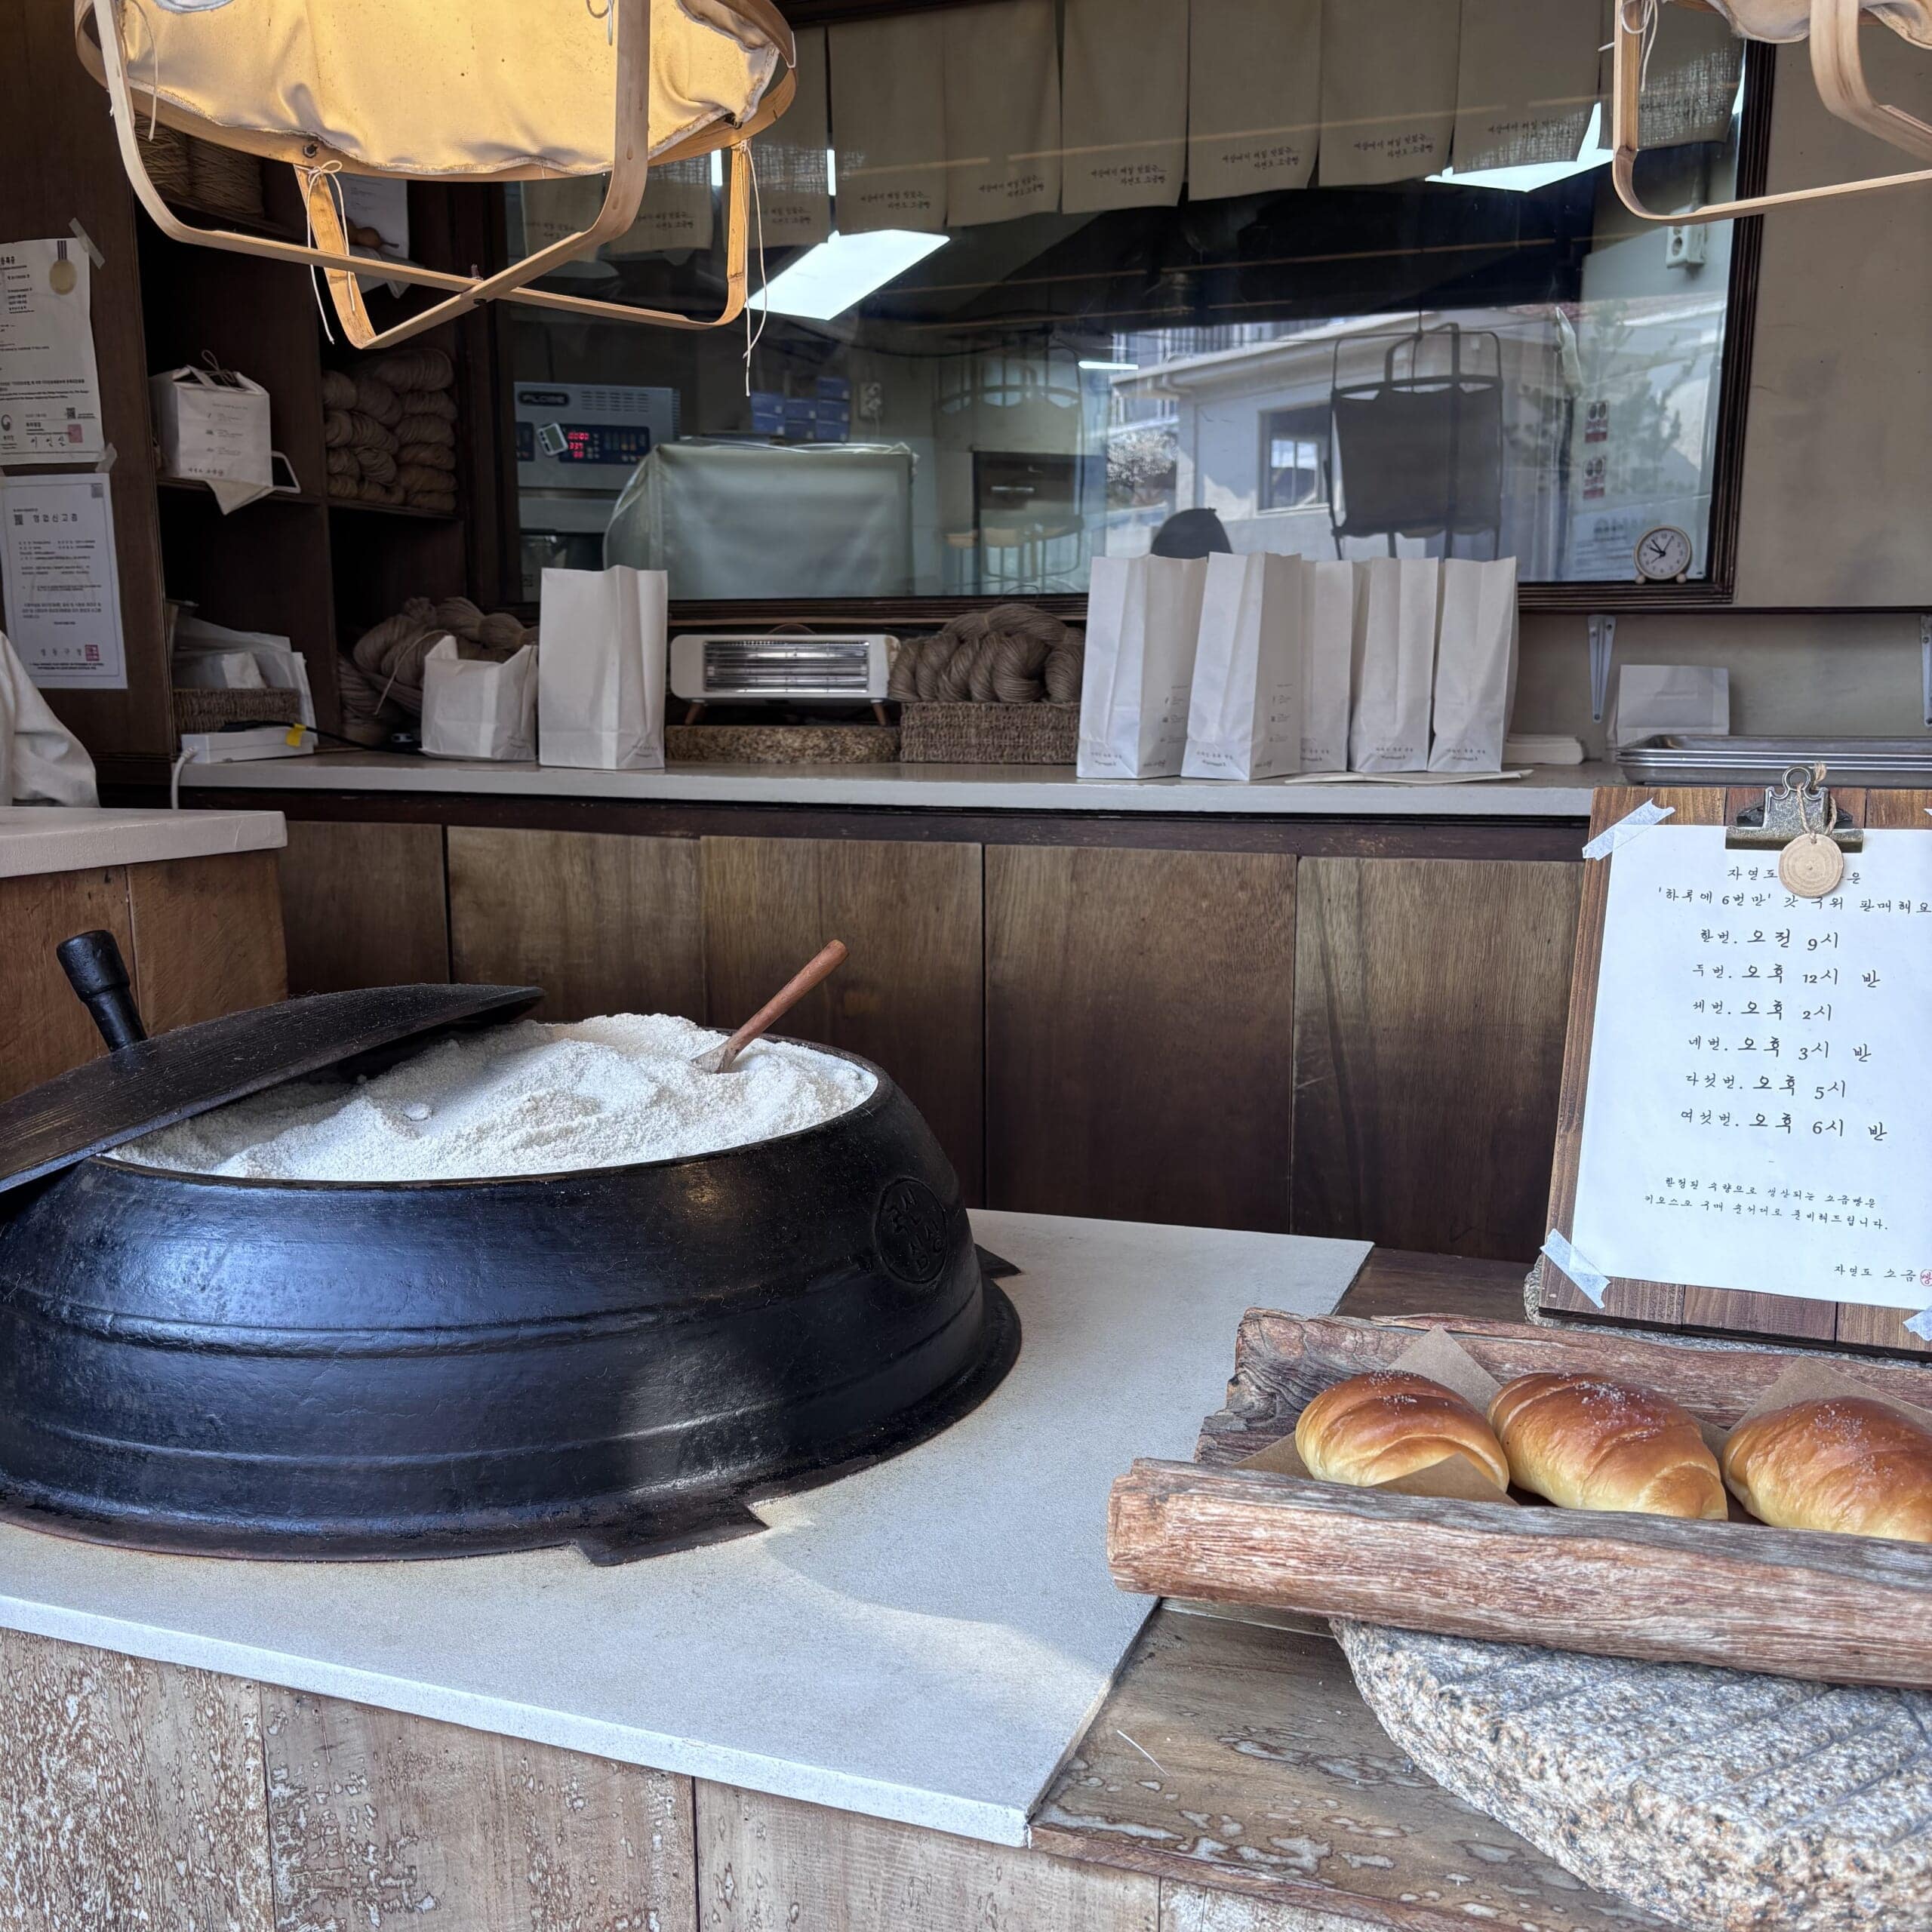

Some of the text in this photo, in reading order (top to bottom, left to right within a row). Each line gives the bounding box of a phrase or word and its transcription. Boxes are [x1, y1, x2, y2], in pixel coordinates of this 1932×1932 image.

[1727, 866, 1778, 881] 자연도
[1859, 898, 1932, 914] 판매해요
[1746, 928, 1791, 949] 오전
[1807, 931, 1838, 952] 9시
[1741, 963, 1783, 984] 오후
[1801, 968, 1838, 986] 12시
[1861, 969, 1881, 989] 반
[1740, 999, 1783, 1021] 오후
[1801, 1003, 1832, 1022] 2시
[1737, 1036, 1780, 1058] 오후
[1798, 1040, 1829, 1061] 3시
[1852, 1043, 1872, 1063] 반
[1752, 1074, 1795, 1097] 오후
[1814, 1079, 1846, 1100] 5시
[1748, 1112, 1792, 1134] 오후
[1812, 1118, 1844, 1137] 6시
[1867, 1121, 1888, 1142] 반
[1665, 1177, 1699, 1190] 한정된
[1708, 1181, 1758, 1195] 수량으로
[1824, 1194, 1876, 1208] 소금빵은
[1644, 1195, 1693, 1207] 키오스크
[1700, 1200, 1724, 1212] 구매
[1732, 1203, 1783, 1217] 순서대로
[1833, 1263, 1872, 1277] 자연도
